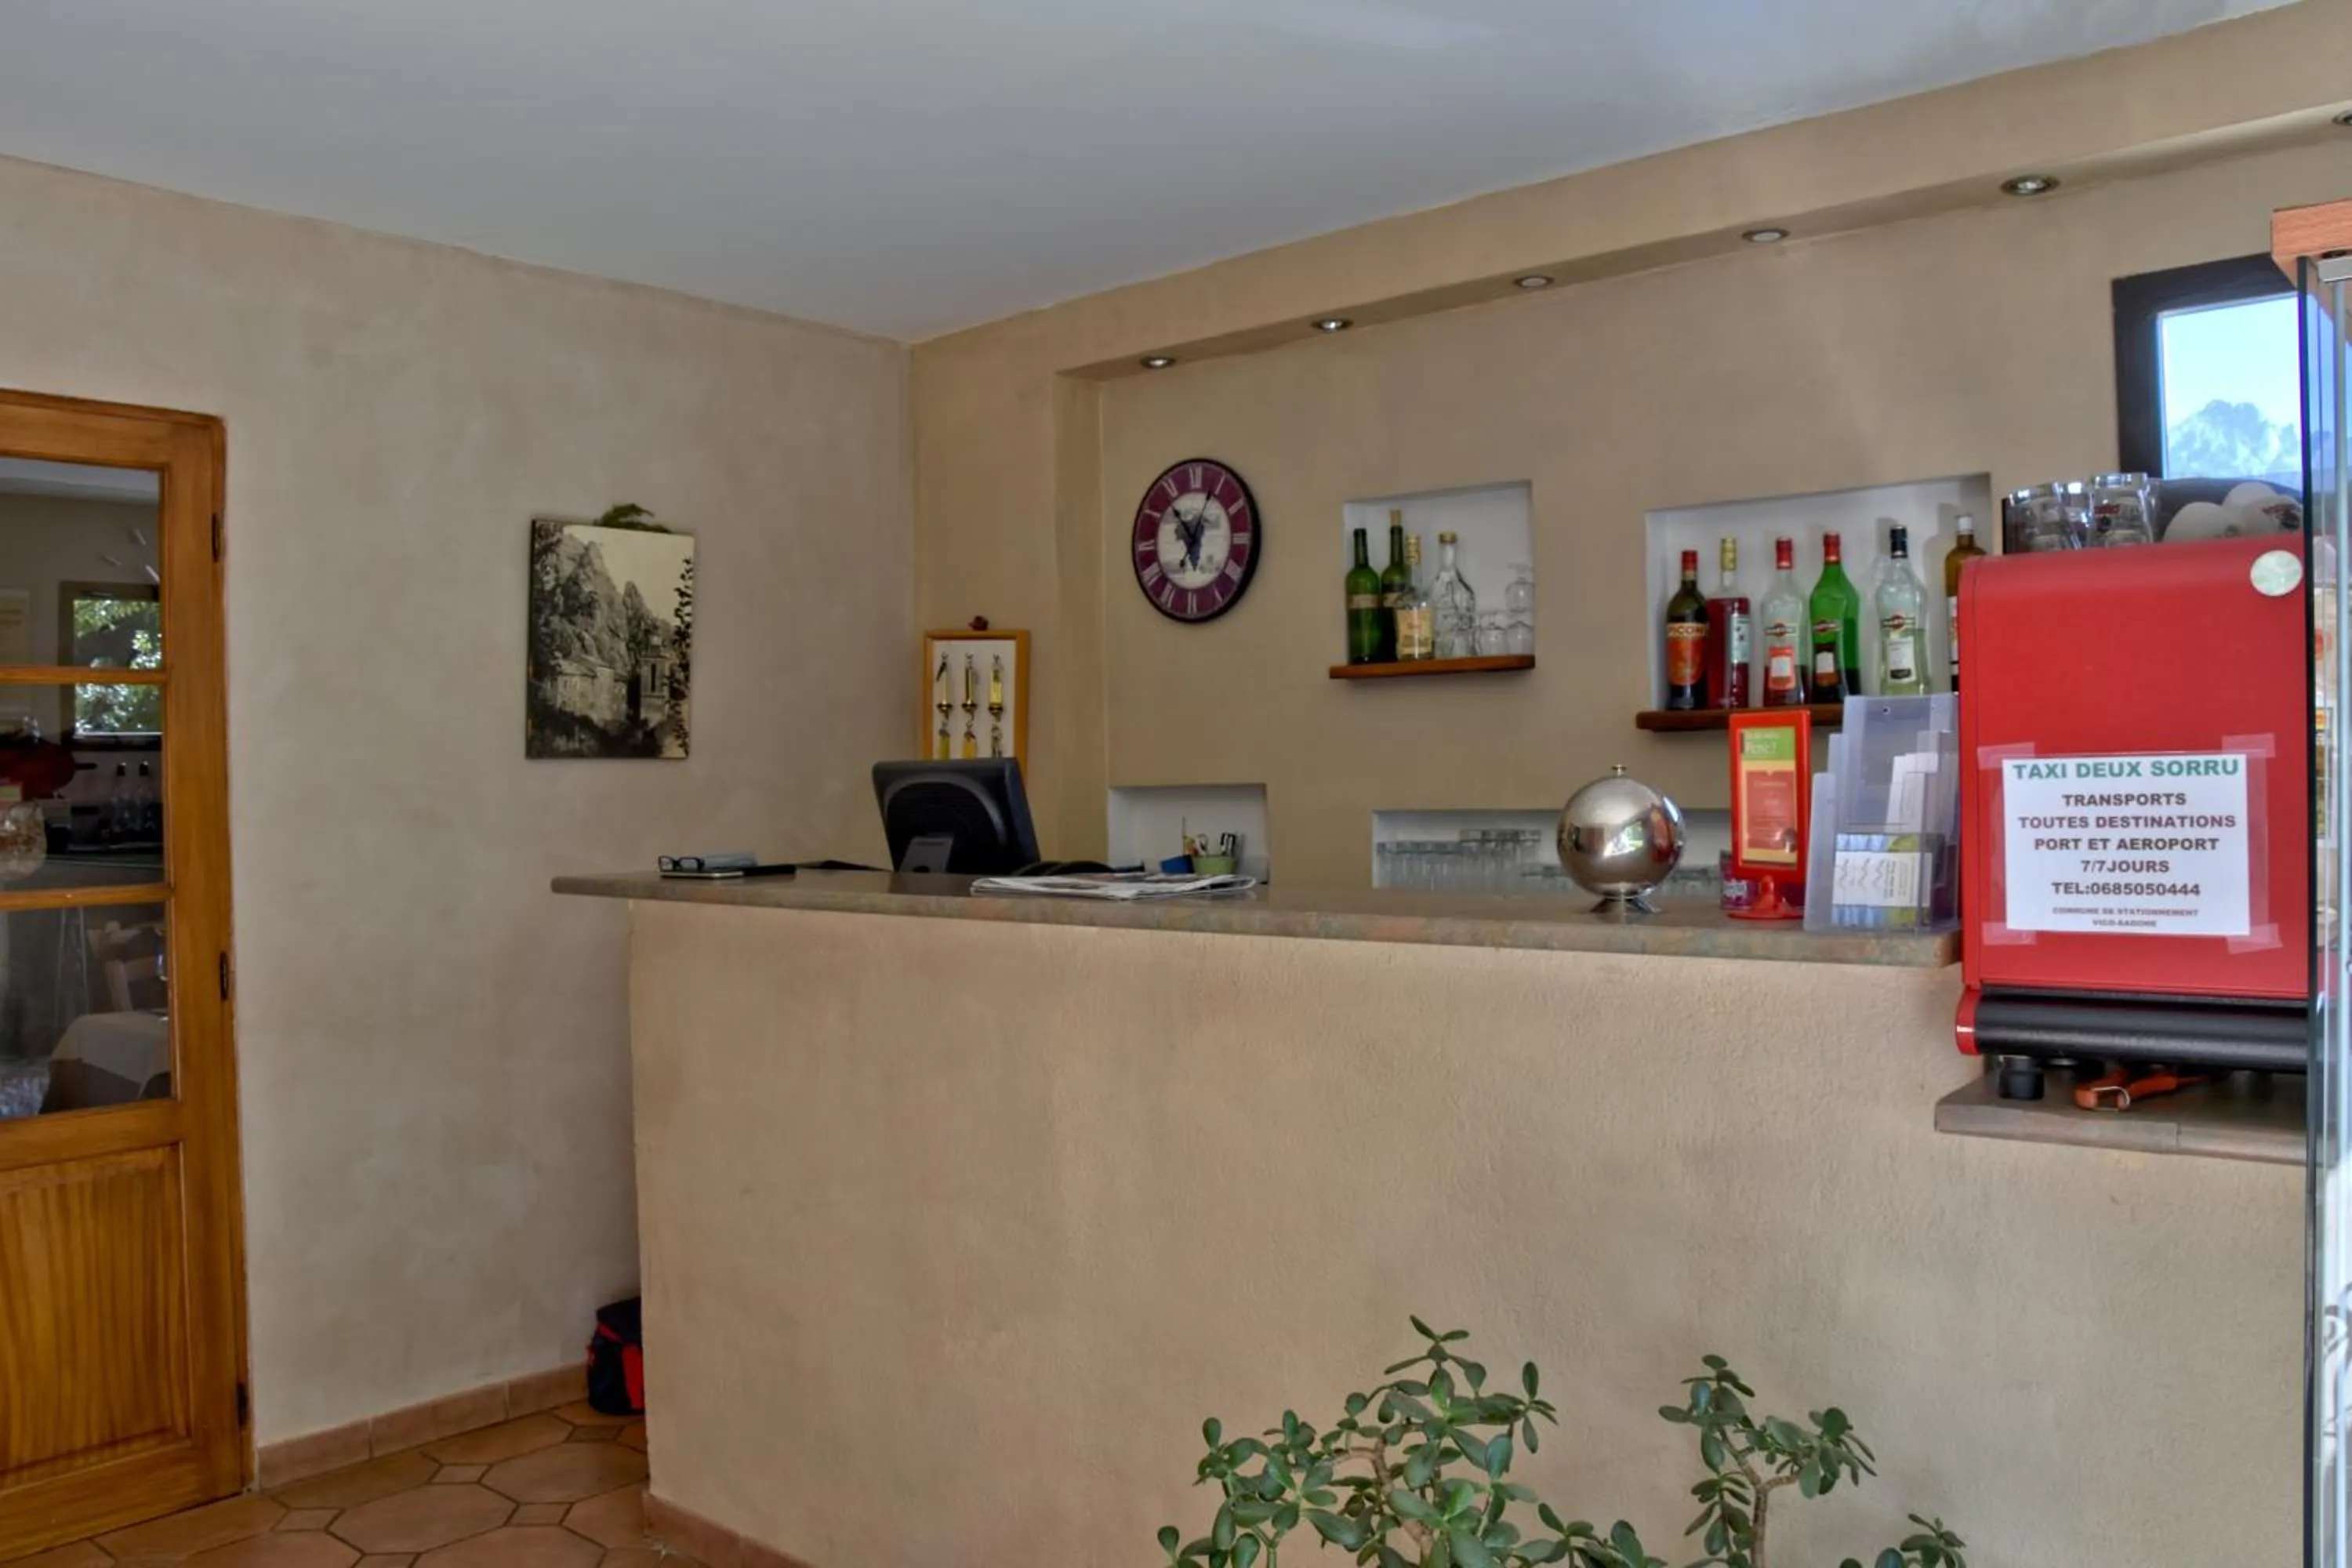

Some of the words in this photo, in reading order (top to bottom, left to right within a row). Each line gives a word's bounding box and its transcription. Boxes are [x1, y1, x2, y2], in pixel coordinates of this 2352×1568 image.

[2013, 762, 2067, 779] TAXI
[2075, 760, 2143, 779] DEUX
[2150, 758, 2240, 777] SORRU
[2062, 793, 2187, 808] TRANSPORTS
[2017, 816, 2089, 829] TOUTES
[2096, 815, 2236, 829] DESTINATIONS
[2034, 838, 2082, 851] PORT
[2088, 838, 2111, 851] ET
[2117, 837, 2220, 851] AEROPORT
[2081, 859, 2169, 873] 7/7JOURS
[2051, 882, 2201, 896] TEL:0685050444
